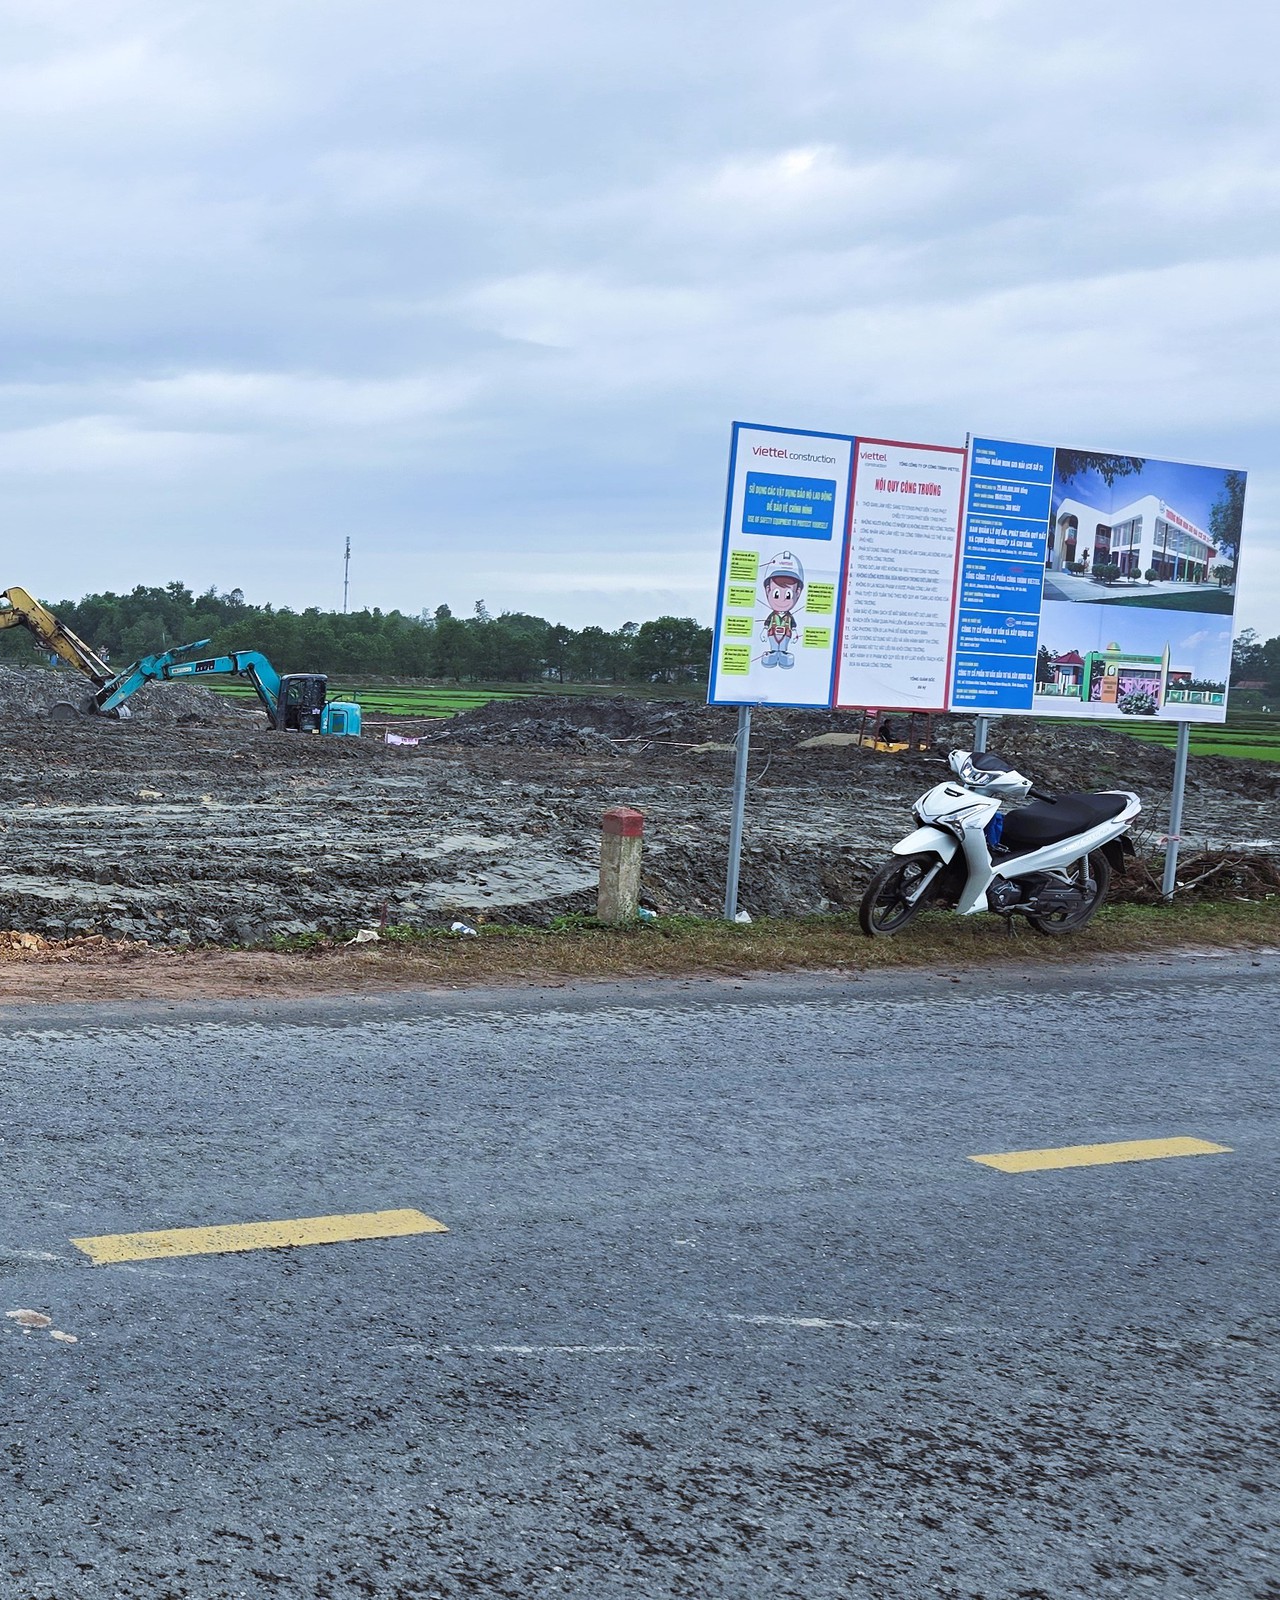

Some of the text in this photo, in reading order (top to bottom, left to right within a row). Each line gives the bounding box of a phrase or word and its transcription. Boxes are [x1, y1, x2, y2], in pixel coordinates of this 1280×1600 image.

[753, 446, 836, 464] viettel construction
[860, 452, 887, 461] viettel
[875, 478, 886, 493] NỘI
[887, 480, 900, 493] QUY
[900, 480, 917, 494] CÔNG
